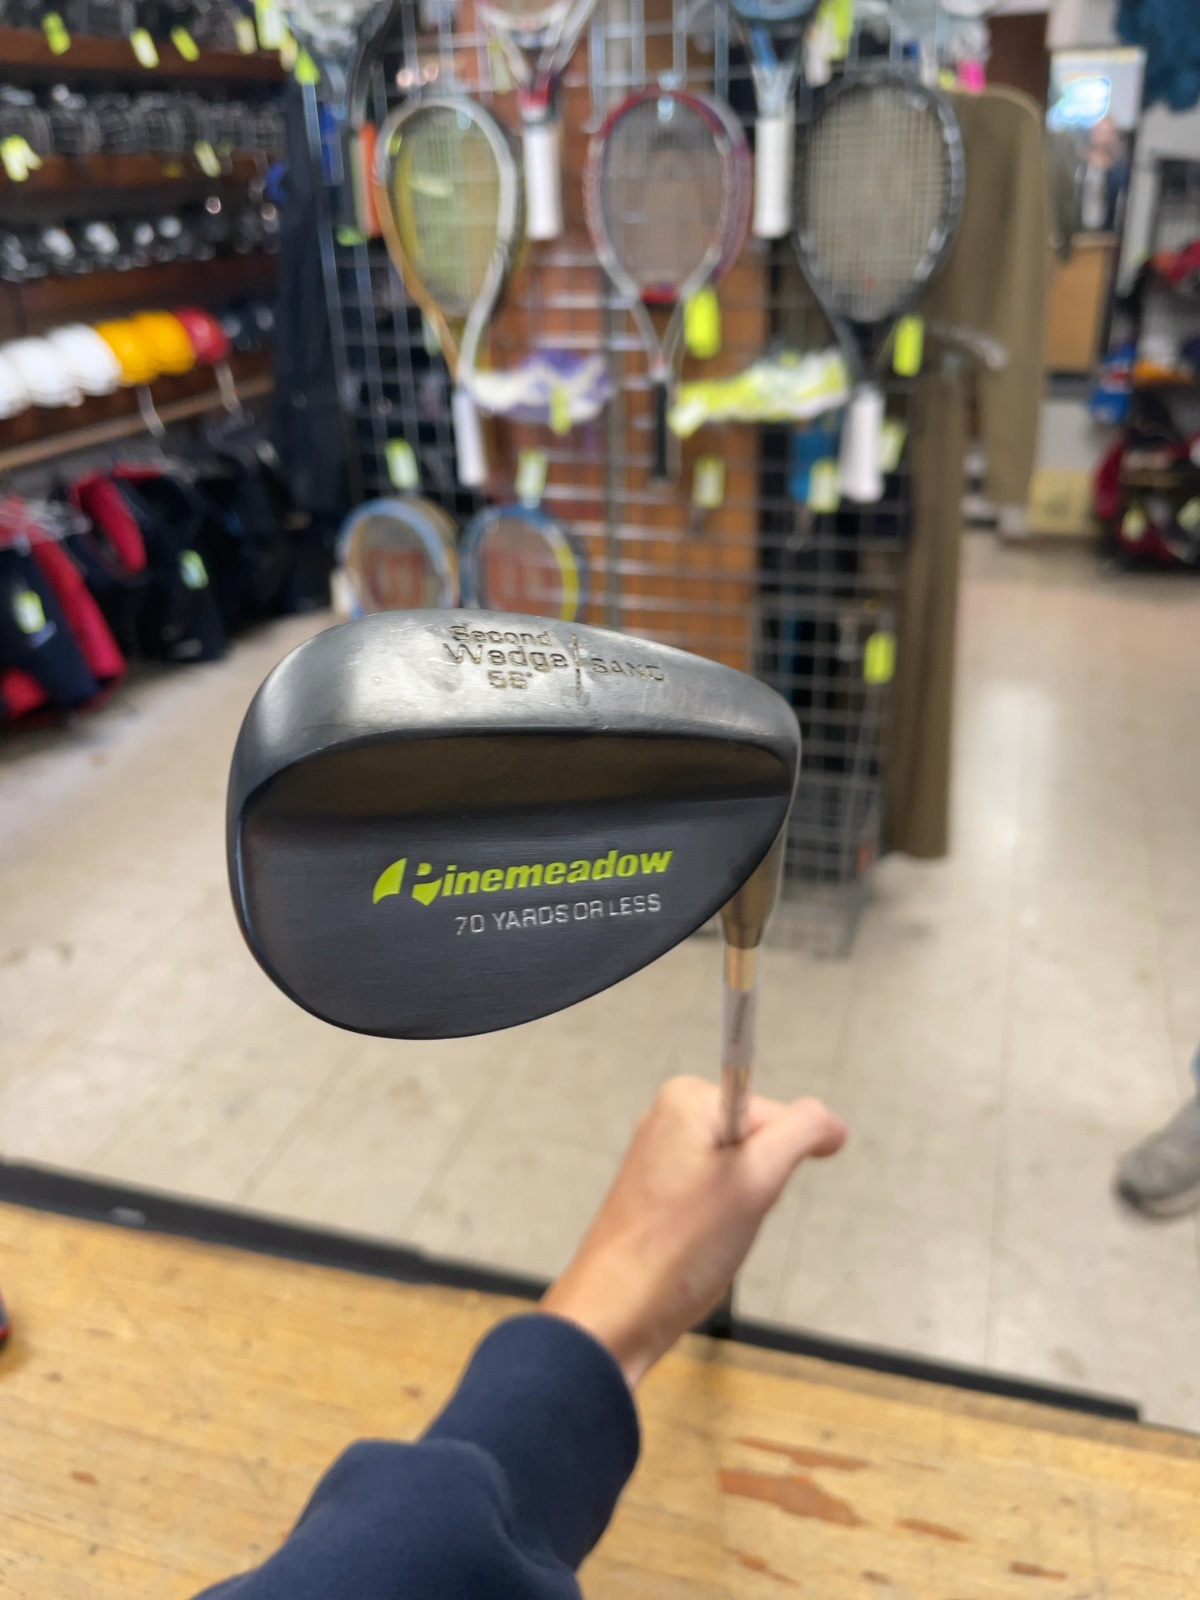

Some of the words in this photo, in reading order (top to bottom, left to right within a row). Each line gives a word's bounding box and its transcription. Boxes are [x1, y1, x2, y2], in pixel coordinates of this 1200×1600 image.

[450, 625, 551, 646] Second
[443, 643, 568, 672] Wedge
[590, 658, 664, 682] SAND
[454, 914, 485, 935] 70
[492, 904, 569, 931] YARDS
[573, 900, 604, 921] OR
[609, 893, 661, 916] LESS
